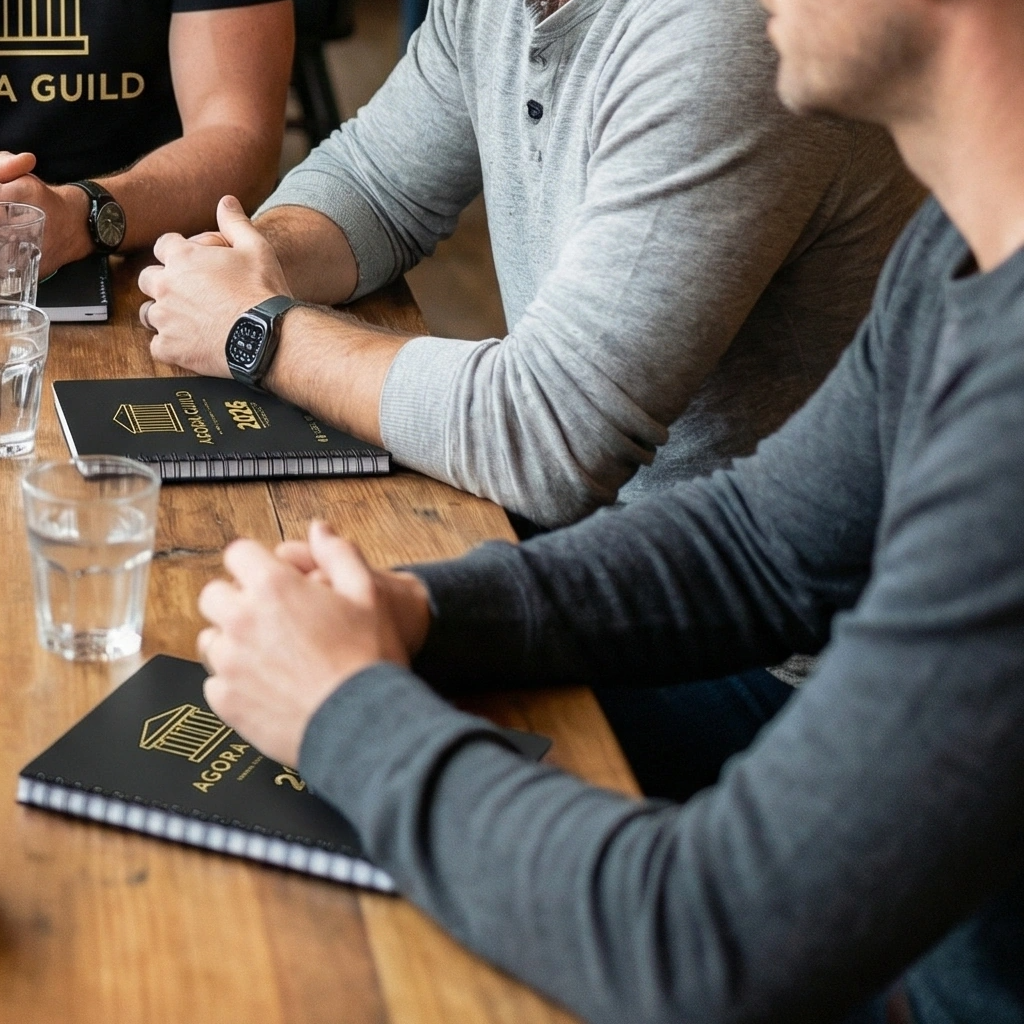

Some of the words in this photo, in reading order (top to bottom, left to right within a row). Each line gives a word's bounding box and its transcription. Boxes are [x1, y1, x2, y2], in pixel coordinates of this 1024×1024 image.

[31, 72, 145, 102] GUILD
[224, 400, 262, 431] 2026
[192, 743, 251, 793] AGORA
